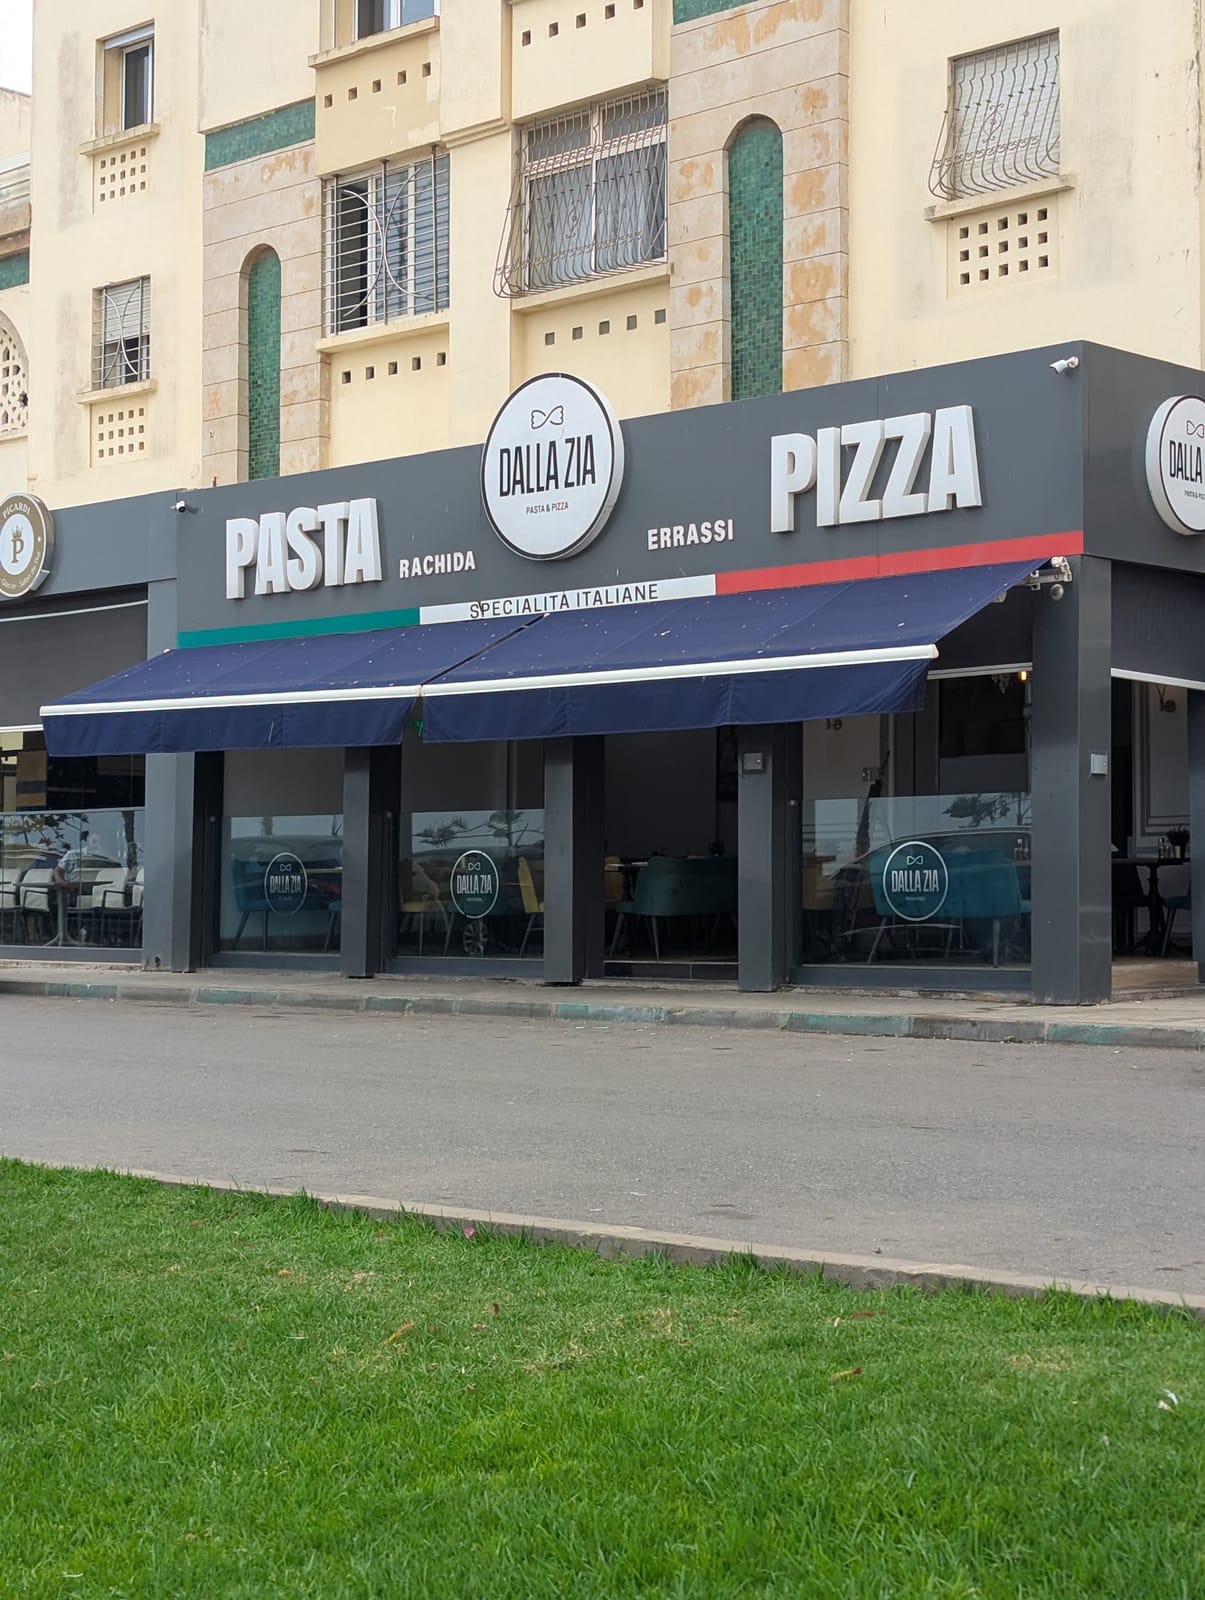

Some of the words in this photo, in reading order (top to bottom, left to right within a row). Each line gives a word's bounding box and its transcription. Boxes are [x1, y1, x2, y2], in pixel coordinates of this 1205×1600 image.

[499, 440, 560, 498] DALLA
[564, 434, 596, 488] ZIA
[771, 405, 982, 533] PIZZA
[1169, 440, 1203, 484] DALLA
[2, 502, 31, 519] PICARDI
[525, 504, 545, 515] PASTA
[551, 501, 569, 511] PIZZA
[647, 519, 734, 550] ERRASSI
[226, 498, 382, 599] PASTA
[399, 550, 476, 579] RACHIDA
[577, 584, 658, 607] ITALIANE
[270, 875, 290, 894] DALLA
[290, 875, 302, 894] ZIA
[456, 874, 480, 895] DALLA
[480, 874, 493, 894] ZIA
[892, 870, 922, 892] DALLA
[923, 869, 939, 892] ZIA
